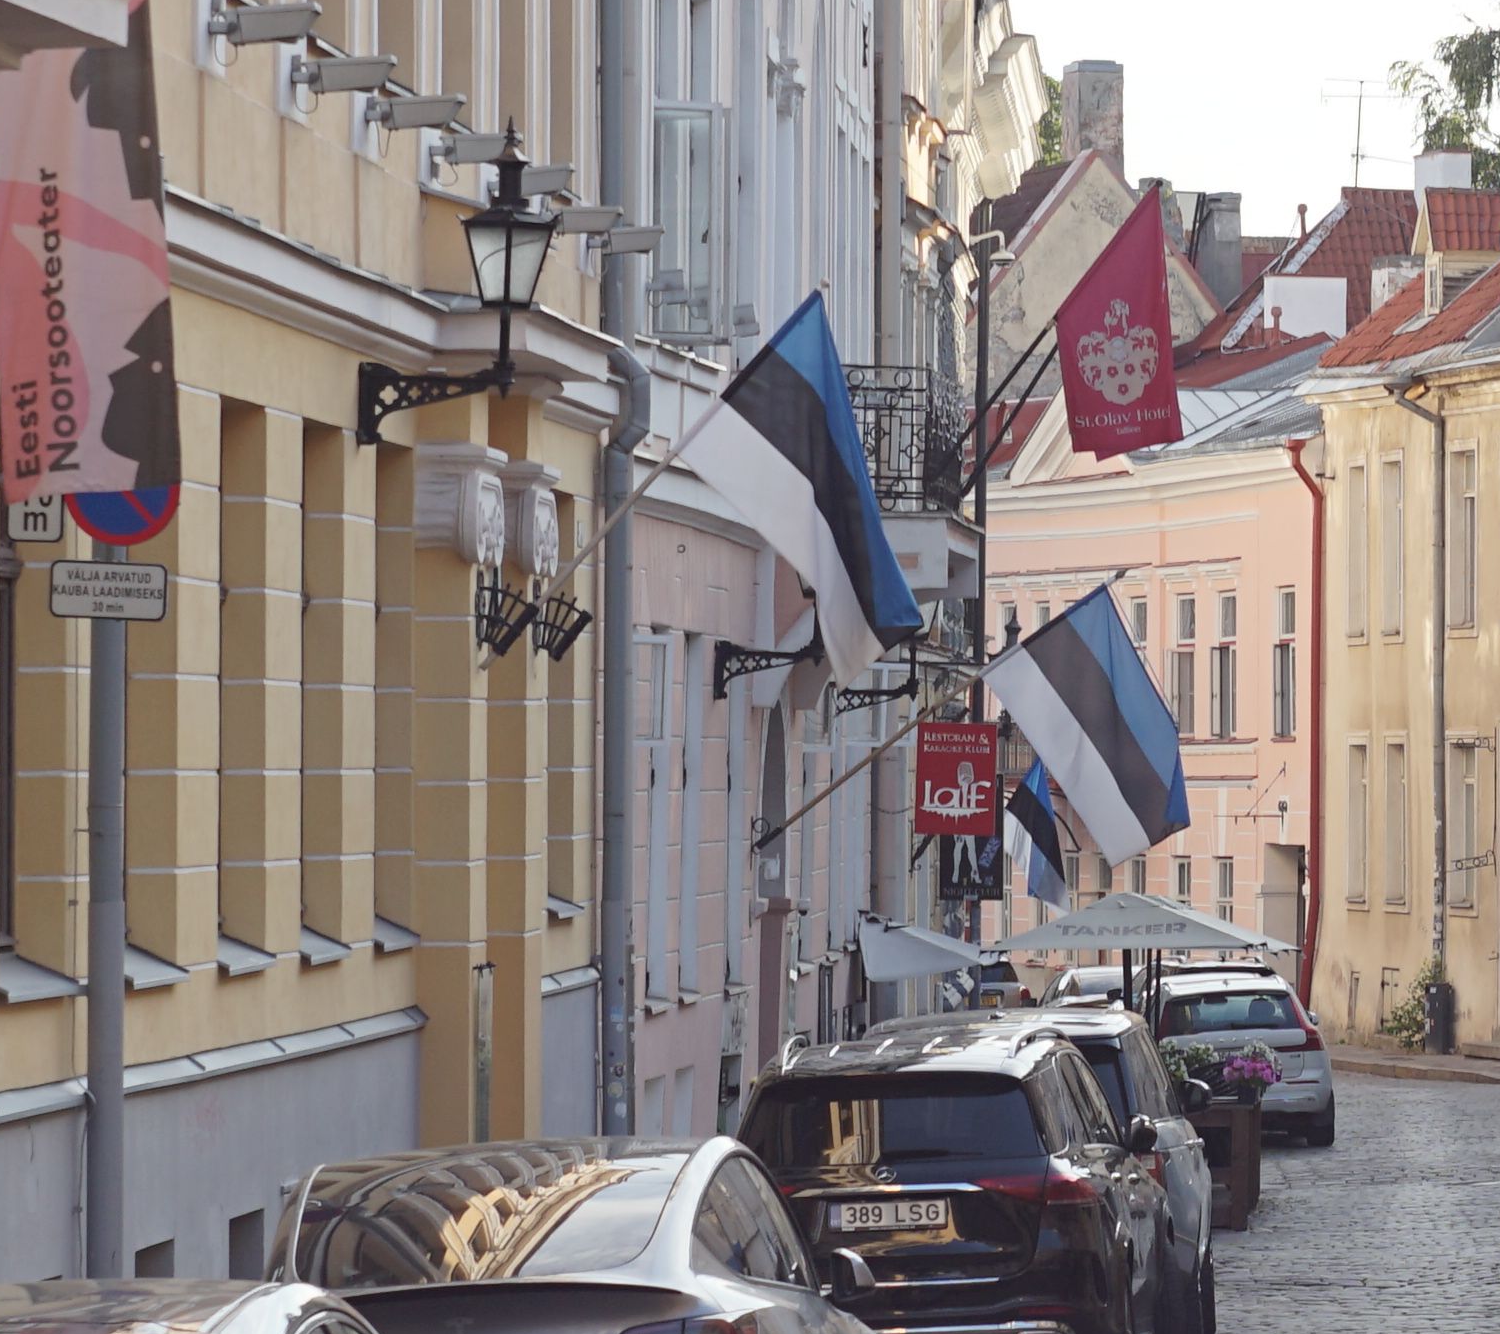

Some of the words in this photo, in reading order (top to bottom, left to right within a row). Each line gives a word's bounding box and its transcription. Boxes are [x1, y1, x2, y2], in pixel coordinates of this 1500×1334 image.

[37, 166, 82, 475] Noorsooteater
[1136, 404, 1172, 422] Hotel
[15, 377, 42, 482] Eesti
[23, 511, 48, 532] m
[67, 568, 100, 581] VÄLJA
[103, 570, 152, 584] ARVATUD
[52, 584, 89, 595] KAUBA
[92, 585, 164, 600] LAADIMISEKS
[105, 603, 124, 612] min
[1055, 922, 1187, 937] TANKER
[845, 1205, 883, 1225] 389
[894, 1203, 940, 1224] LSG
